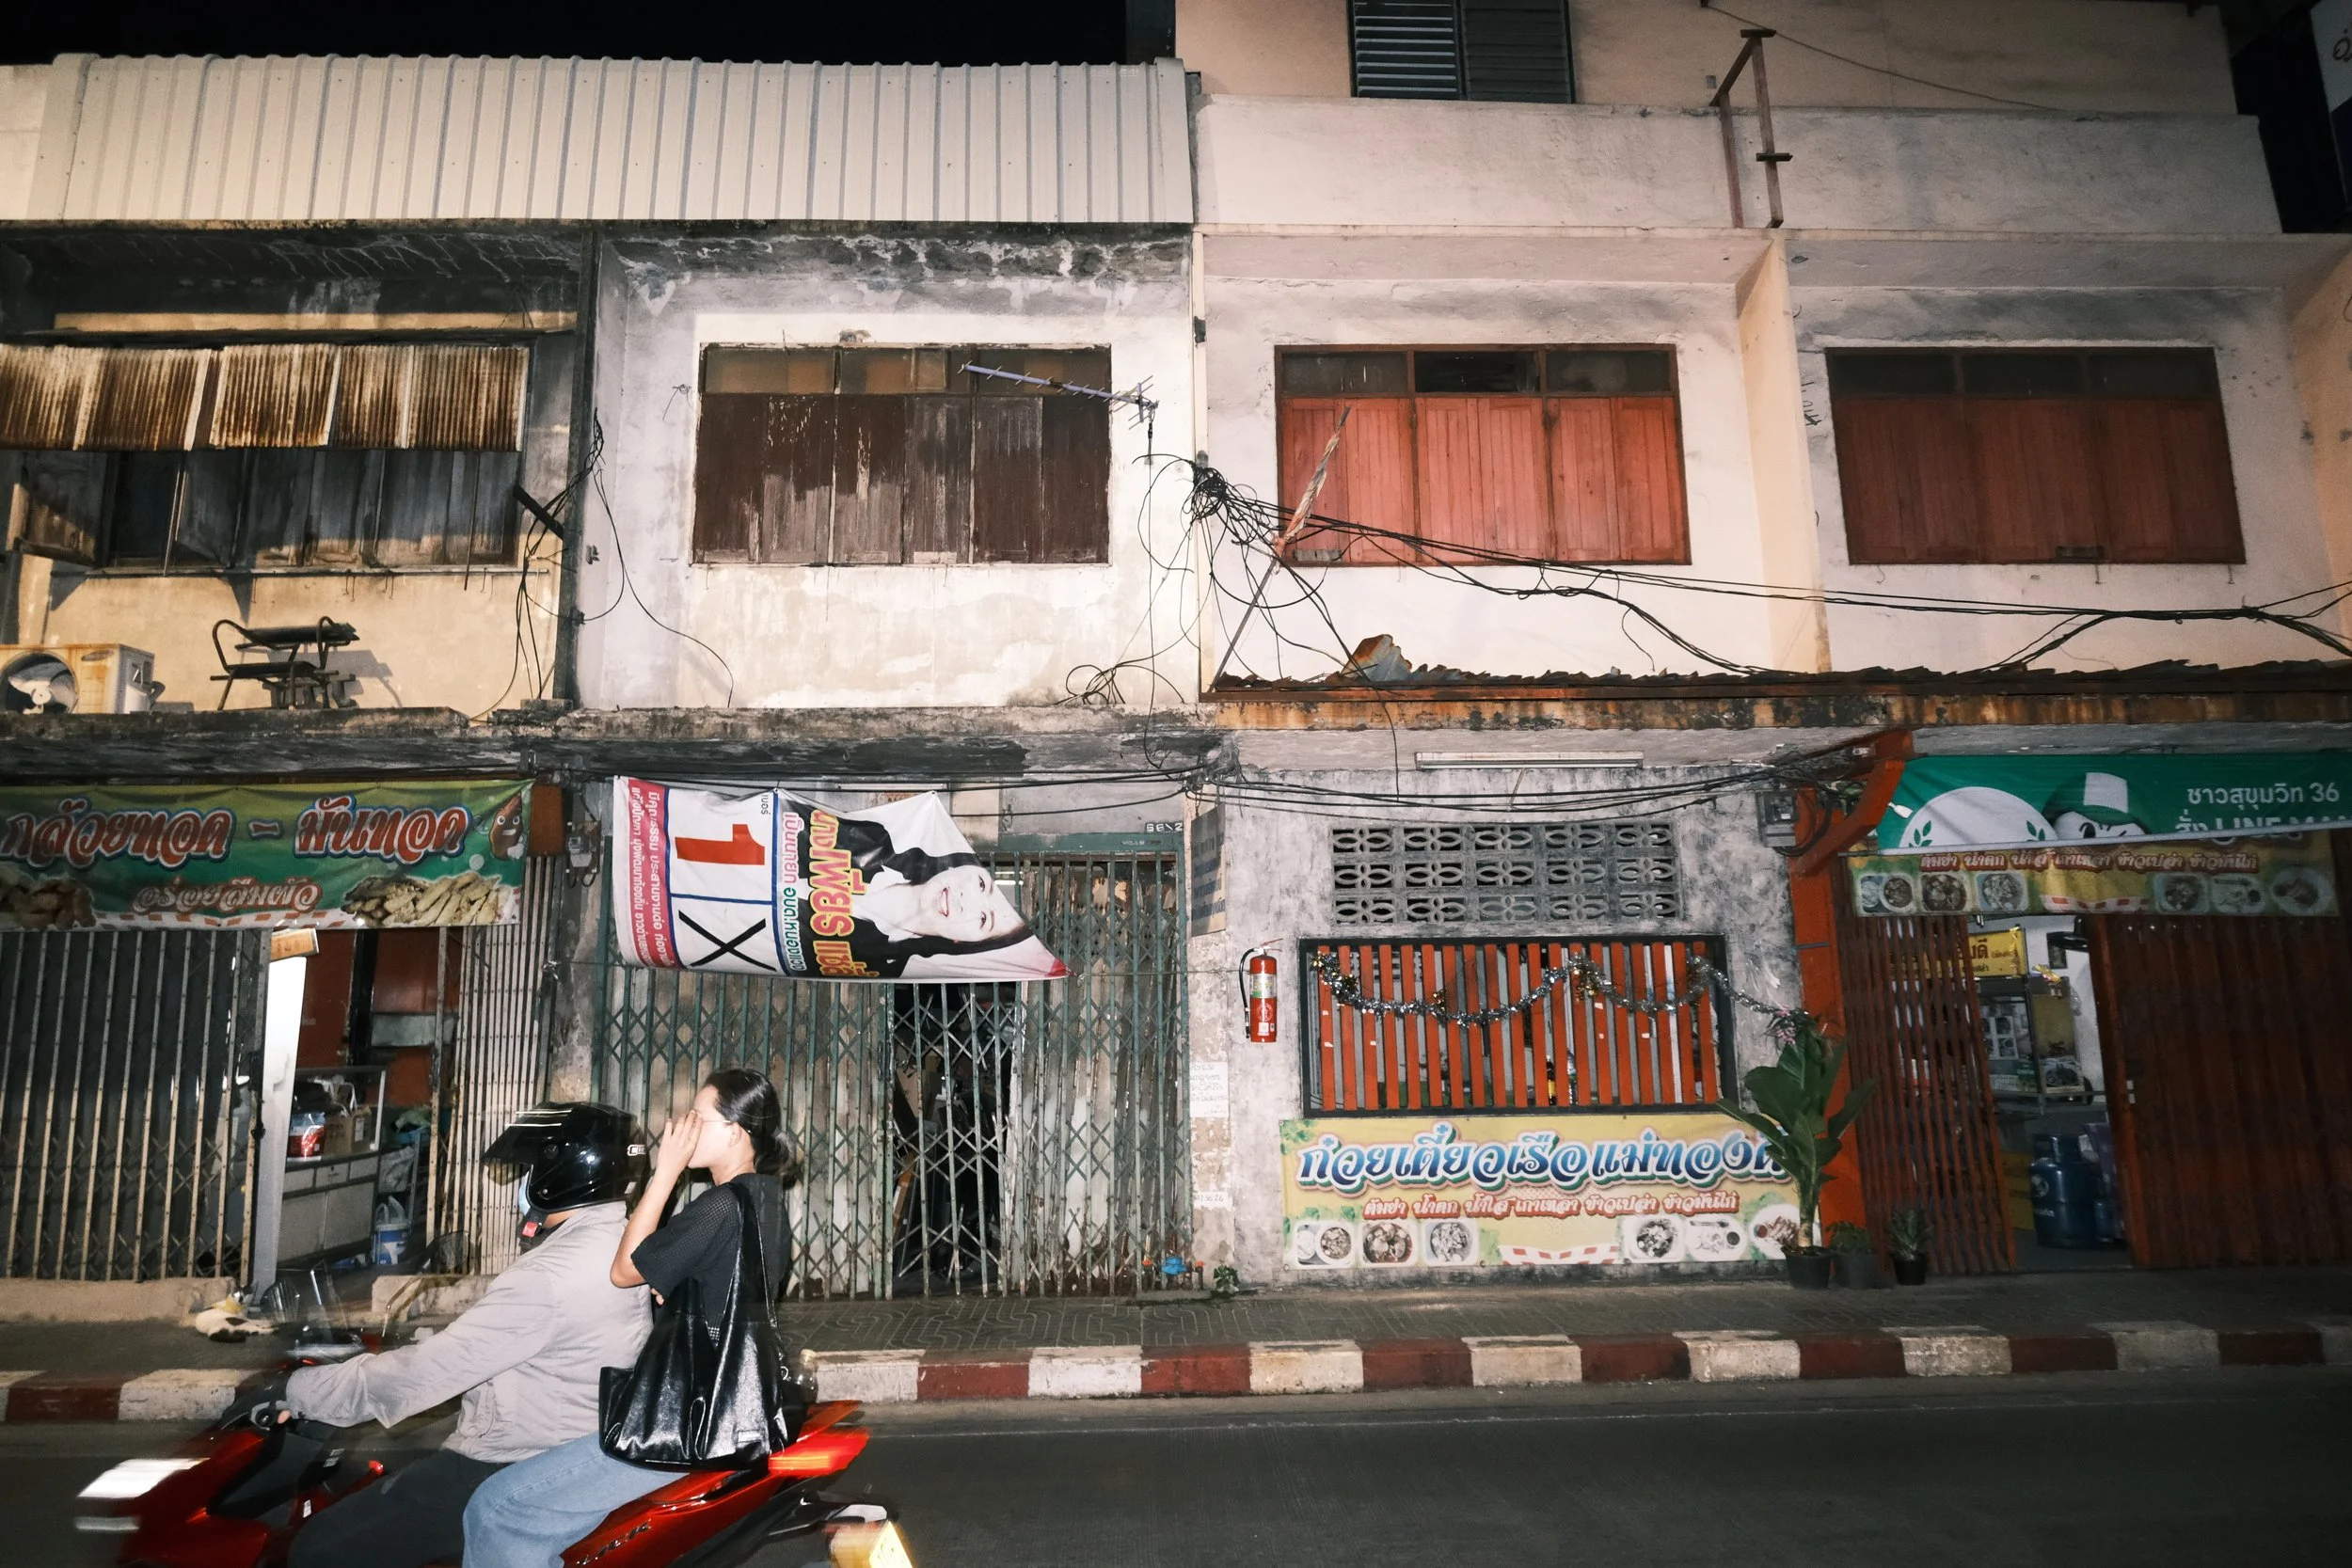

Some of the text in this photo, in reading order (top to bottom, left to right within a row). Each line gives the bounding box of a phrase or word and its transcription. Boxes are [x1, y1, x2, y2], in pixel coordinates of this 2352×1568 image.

[761, 794, 771, 815] เบอร์
[2187, 783, 2340, 810] ชาวสุขุมวิท 36
[2, 799, 233, 867] กล้วยทอด
[294, 796, 469, 864] มันทอด
[675, 824, 765, 865] 1
[1364, 1197, 1407, 1215] ต้มยำ
[1413, 1193, 1458, 1214] น้ำตก
